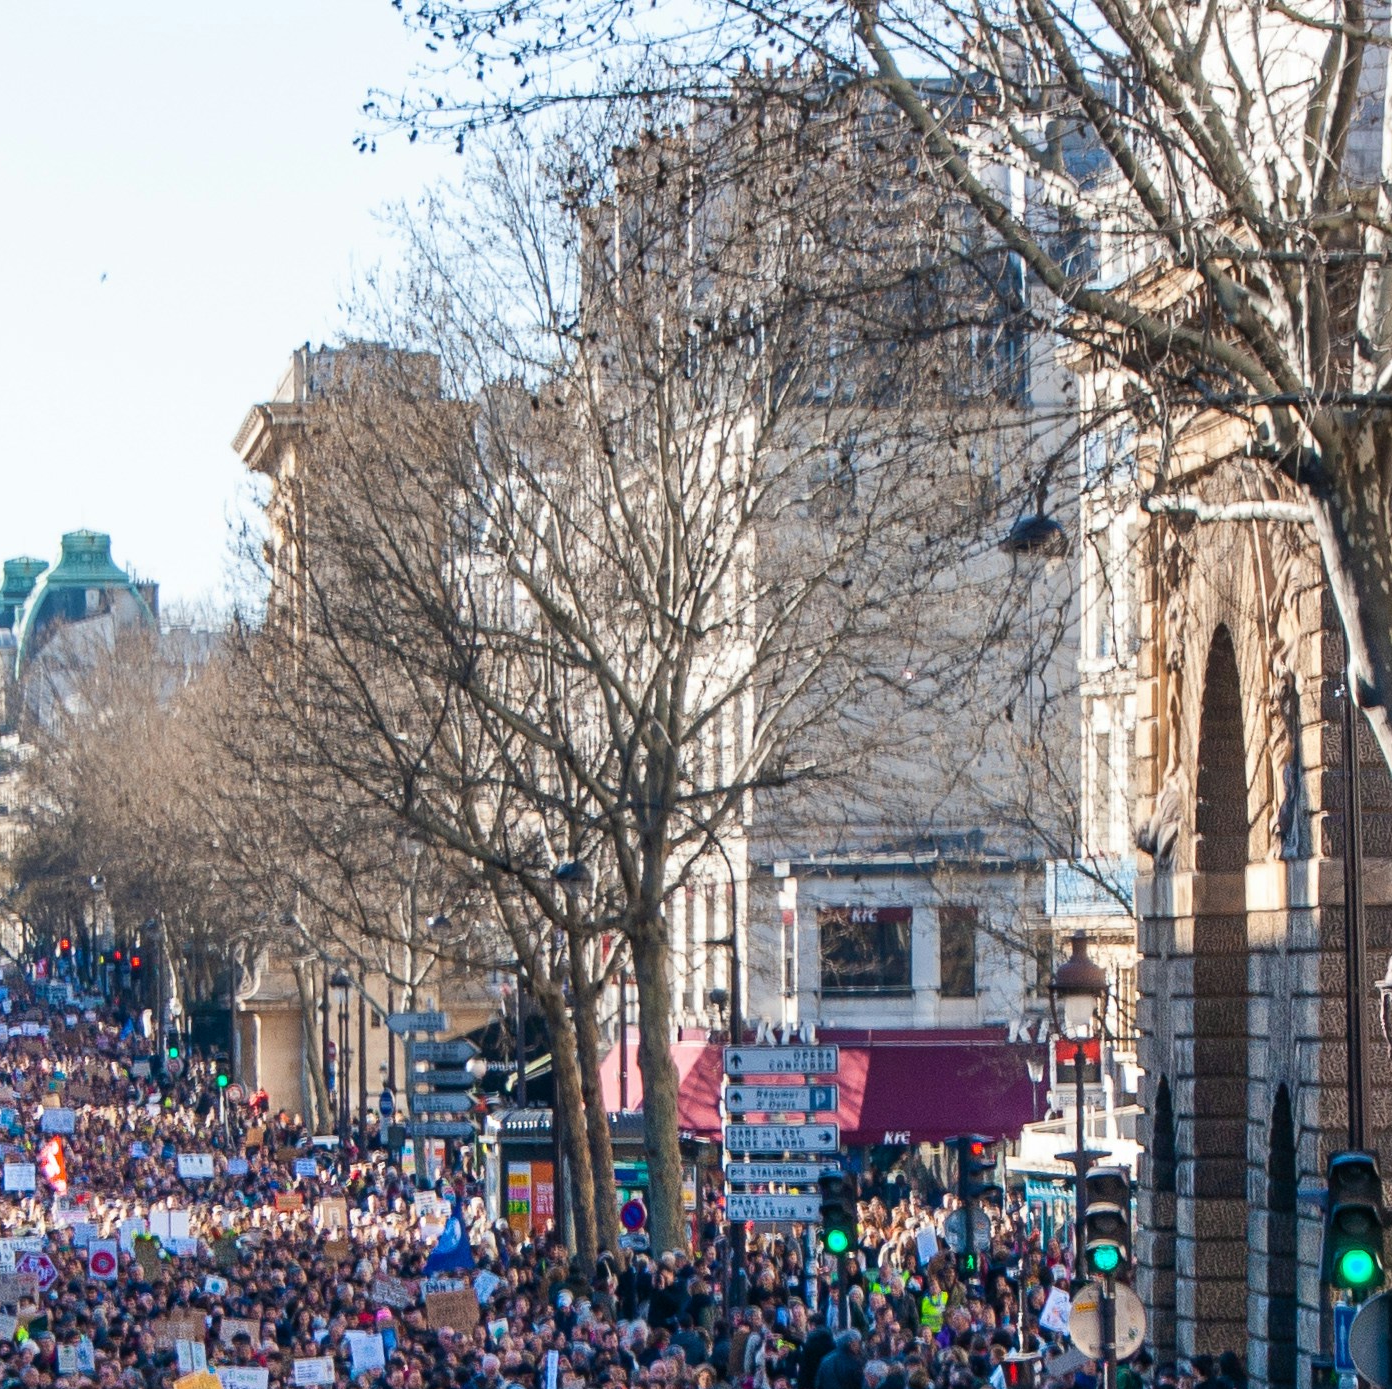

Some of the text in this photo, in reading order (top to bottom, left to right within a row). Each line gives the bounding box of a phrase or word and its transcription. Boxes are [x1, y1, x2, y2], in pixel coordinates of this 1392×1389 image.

[852, 909, 878, 923] KFC
[730, 1130, 758, 1138] GARE
[884, 1131, 911, 1144] KFC
[730, 1139, 806, 1148] GARE NORD
[750, 1168, 807, 1177] STALINGRAD
